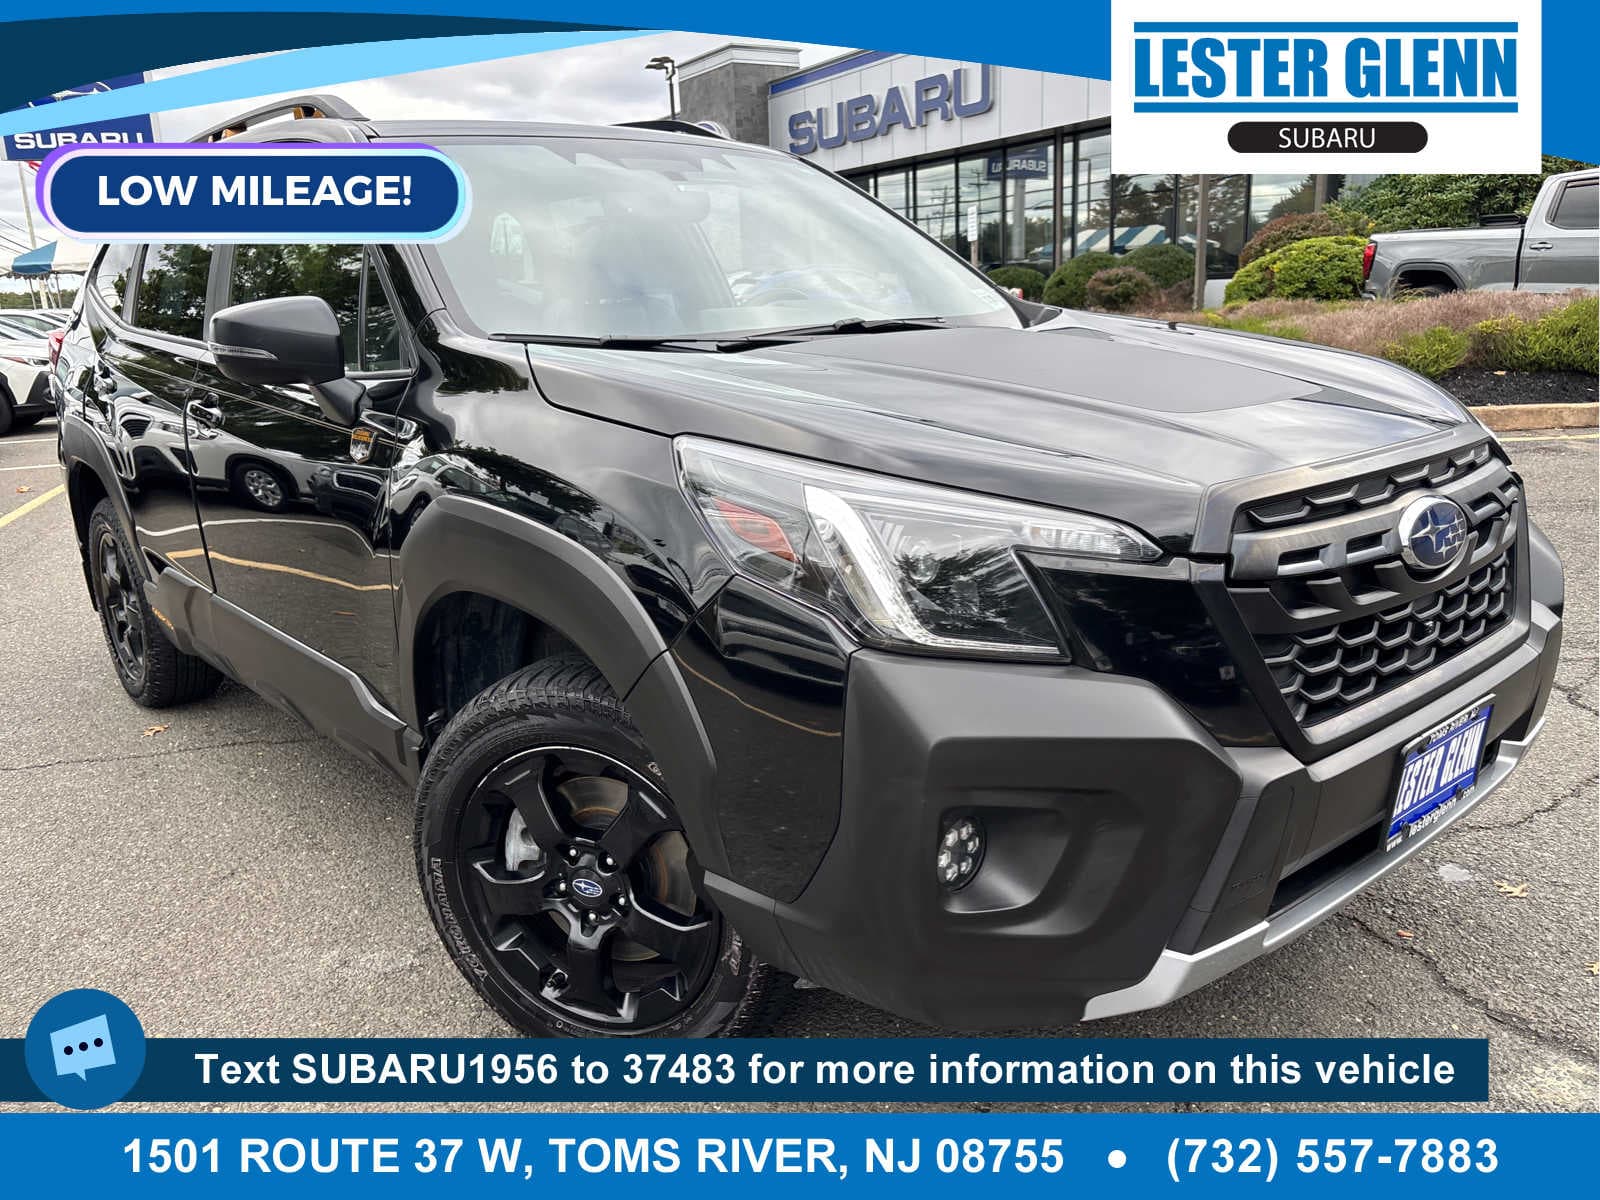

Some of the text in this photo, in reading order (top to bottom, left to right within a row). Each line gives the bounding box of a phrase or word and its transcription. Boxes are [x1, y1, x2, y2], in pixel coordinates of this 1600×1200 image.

[788, 64, 994, 155] SUBARU
[1393, 720, 1486, 818] LESTER GLENN
